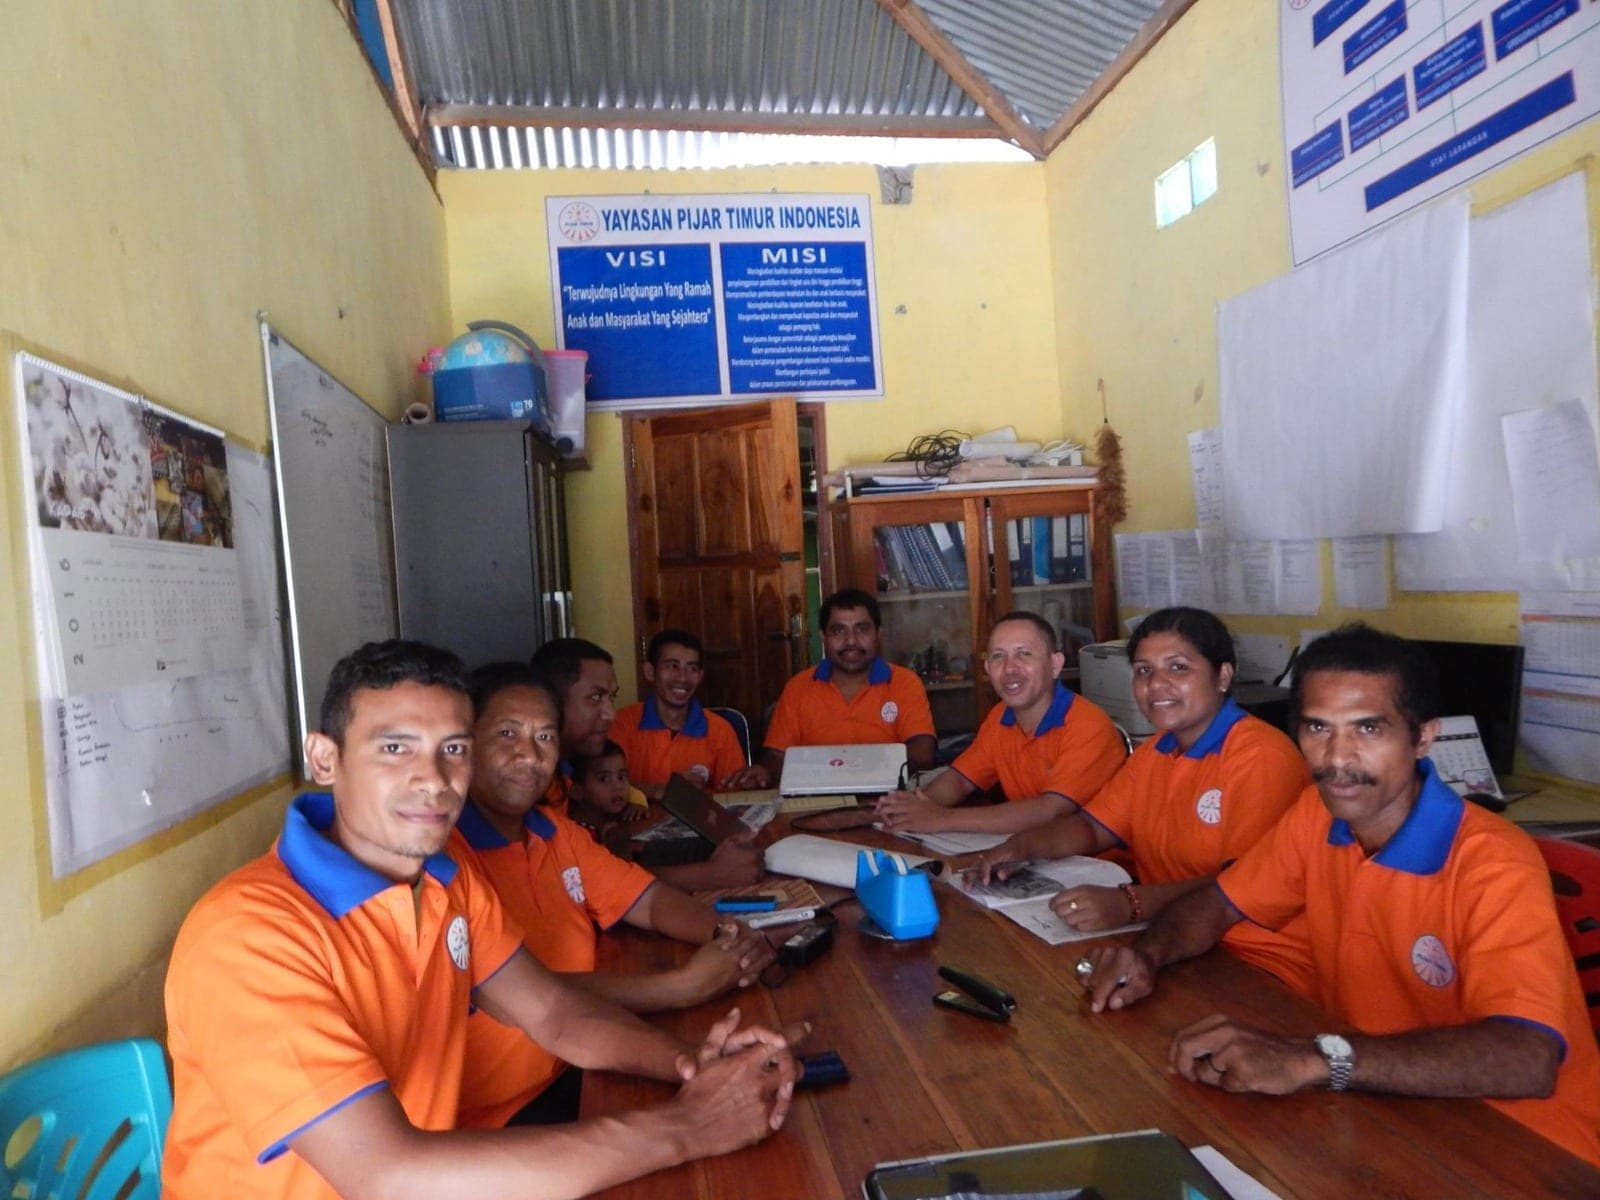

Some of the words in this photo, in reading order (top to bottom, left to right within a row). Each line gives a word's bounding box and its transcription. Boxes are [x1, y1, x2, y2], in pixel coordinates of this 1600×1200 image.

[601, 208, 673, 231] YAYASAN
[677, 207, 722, 231] PIJAR
[726, 207, 774, 230] TIMUR
[780, 206, 861, 229] INDONESIA
[605, 250, 667, 268] VISI
[762, 247, 828, 264] MISI
[619, 281, 663, 301] Lingkungan
[664, 281, 684, 300] Yang
[684, 280, 712, 296] Ramah
[567, 313, 588, 329] Anak
[588, 312, 605, 328] dan
[605, 310, 650, 330] Masyarakat
[651, 310, 671, 328] Yang
